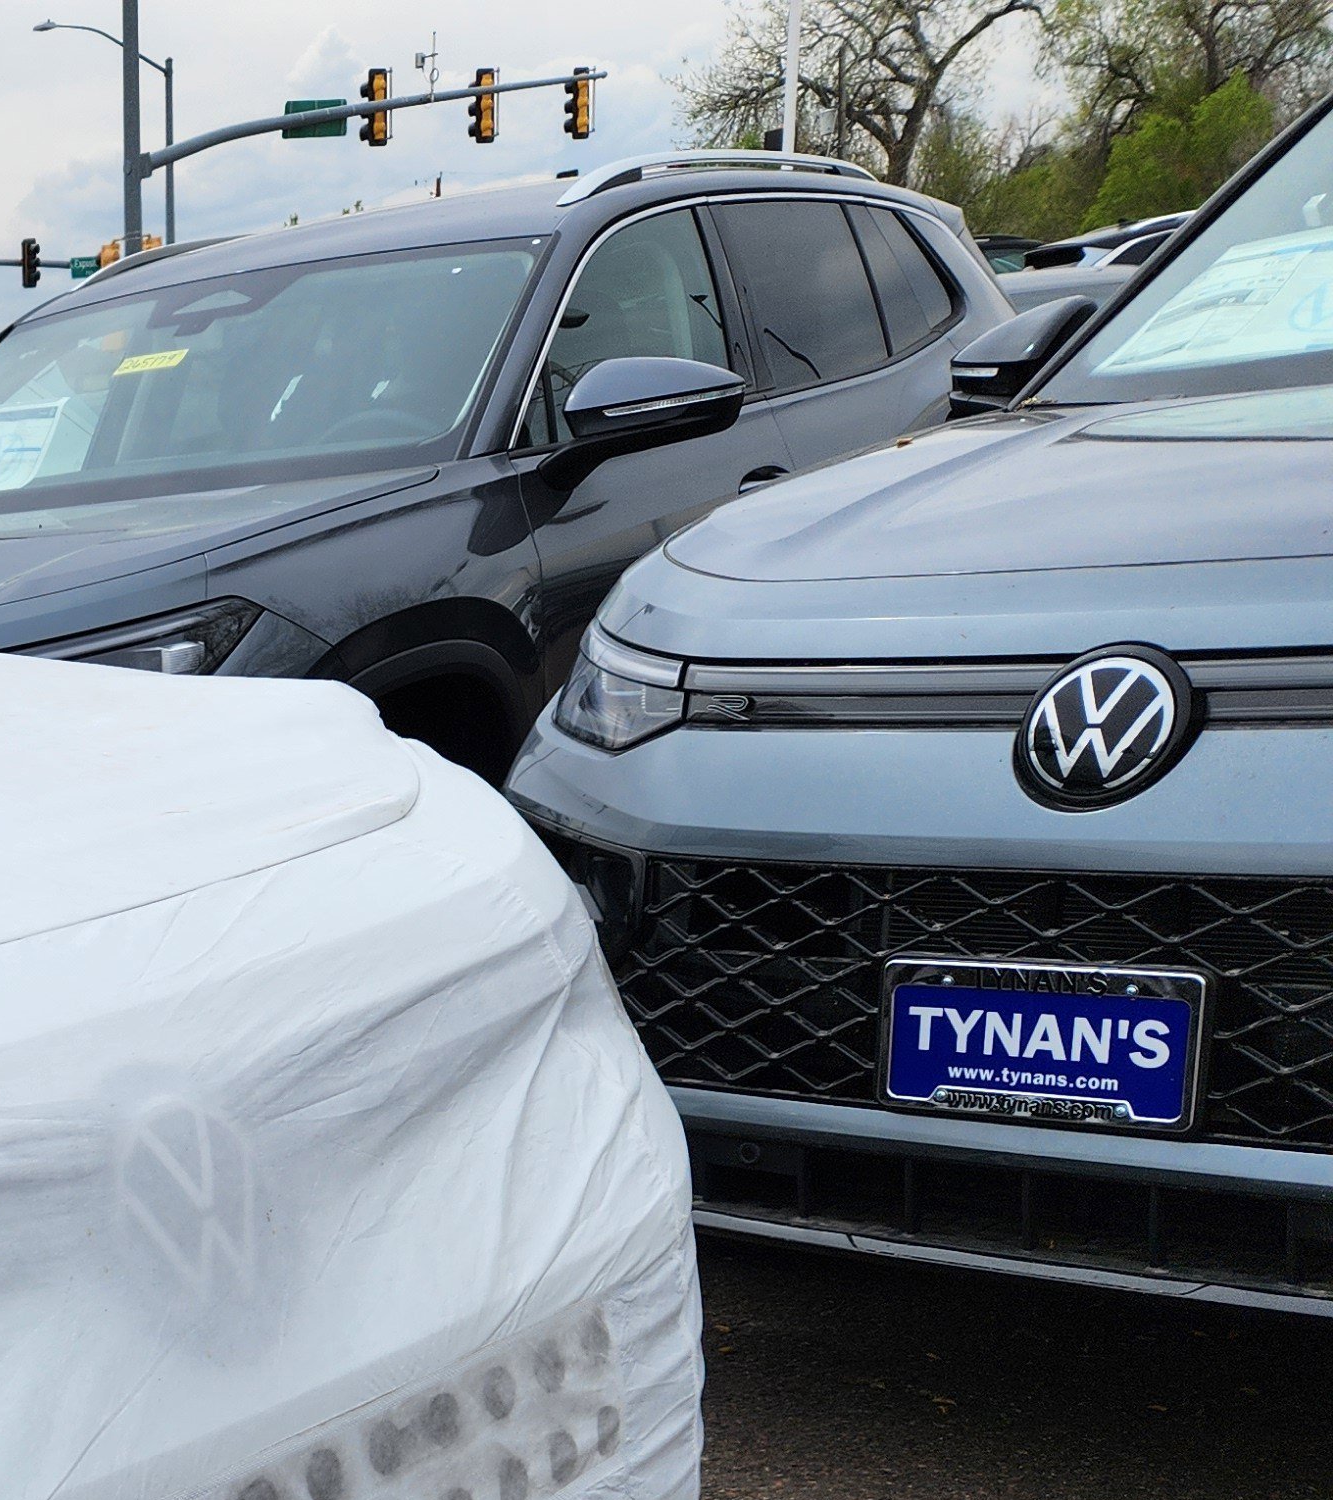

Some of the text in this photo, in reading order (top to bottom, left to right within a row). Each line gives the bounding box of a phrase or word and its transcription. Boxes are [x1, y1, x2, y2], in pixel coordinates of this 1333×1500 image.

[908, 1005, 1171, 1069] TYNAN'S
[947, 1065, 1120, 1092] www.tynans.com
[944, 1089, 1117, 1121] www.tynans.com
